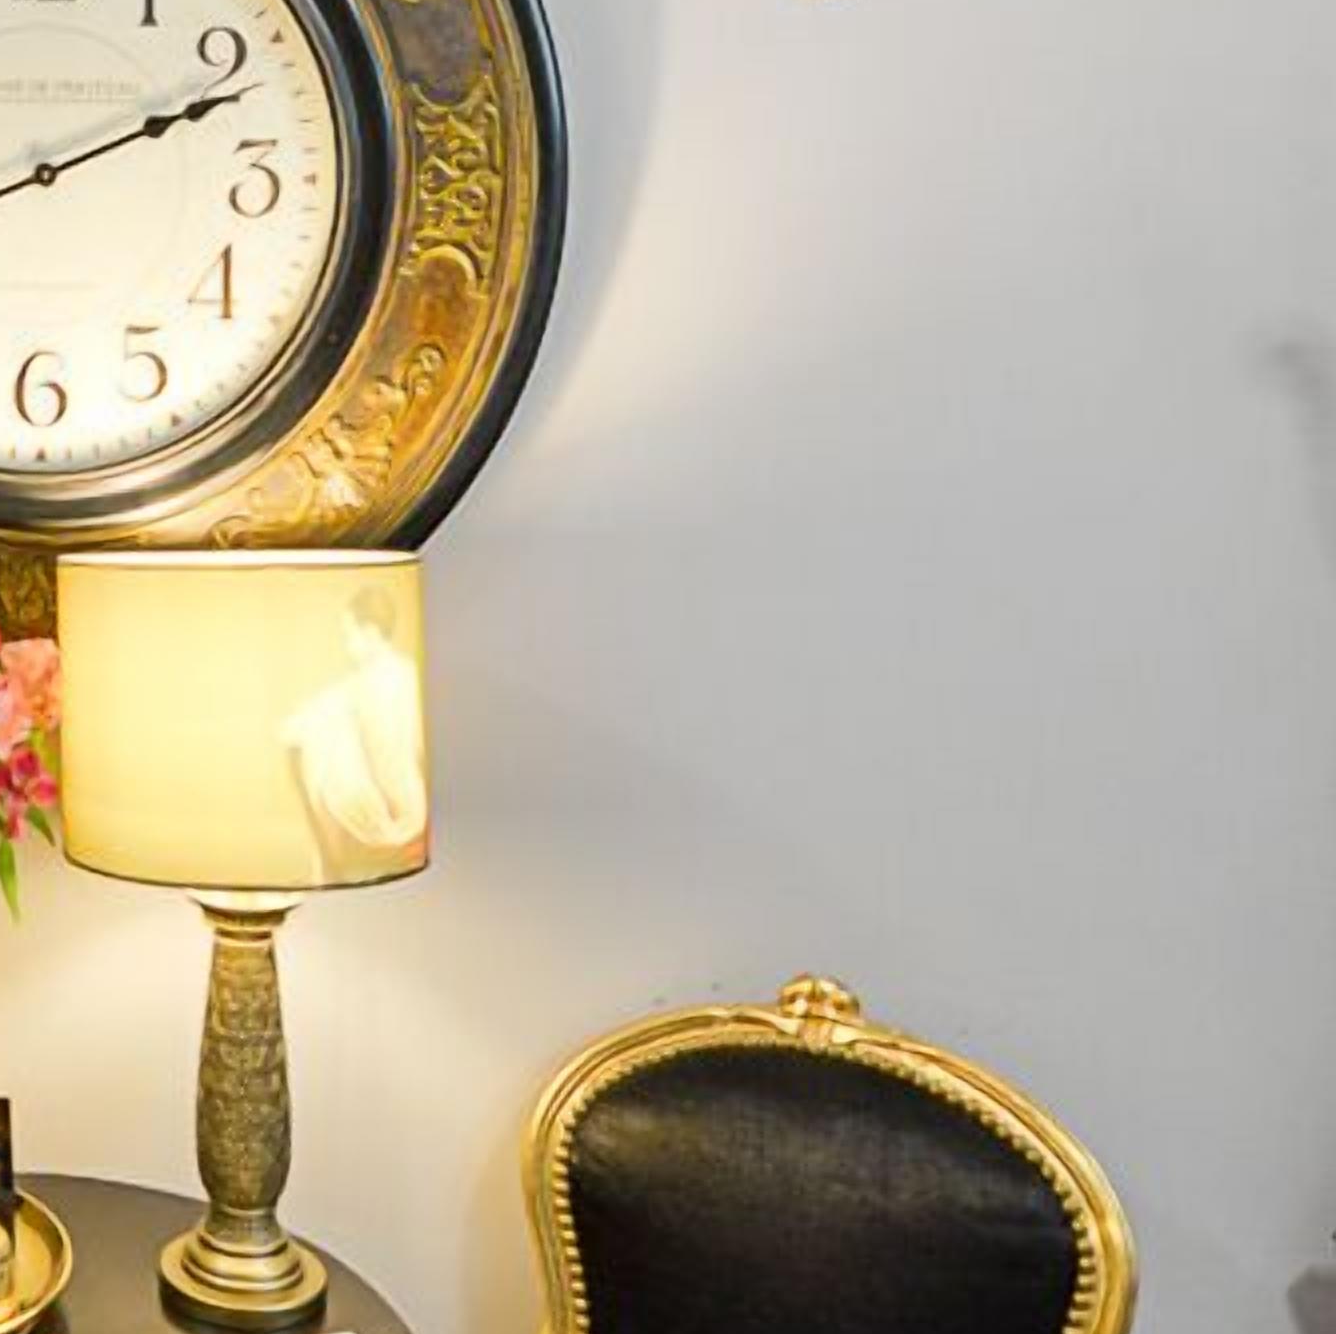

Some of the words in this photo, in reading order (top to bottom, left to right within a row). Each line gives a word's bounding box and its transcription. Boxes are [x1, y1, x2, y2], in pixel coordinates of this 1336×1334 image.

[228, 138, 281, 218] 3
[186, 243, 234, 320] 4
[13, 350, 68, 427] 6
[117, 324, 168, 402] 5
